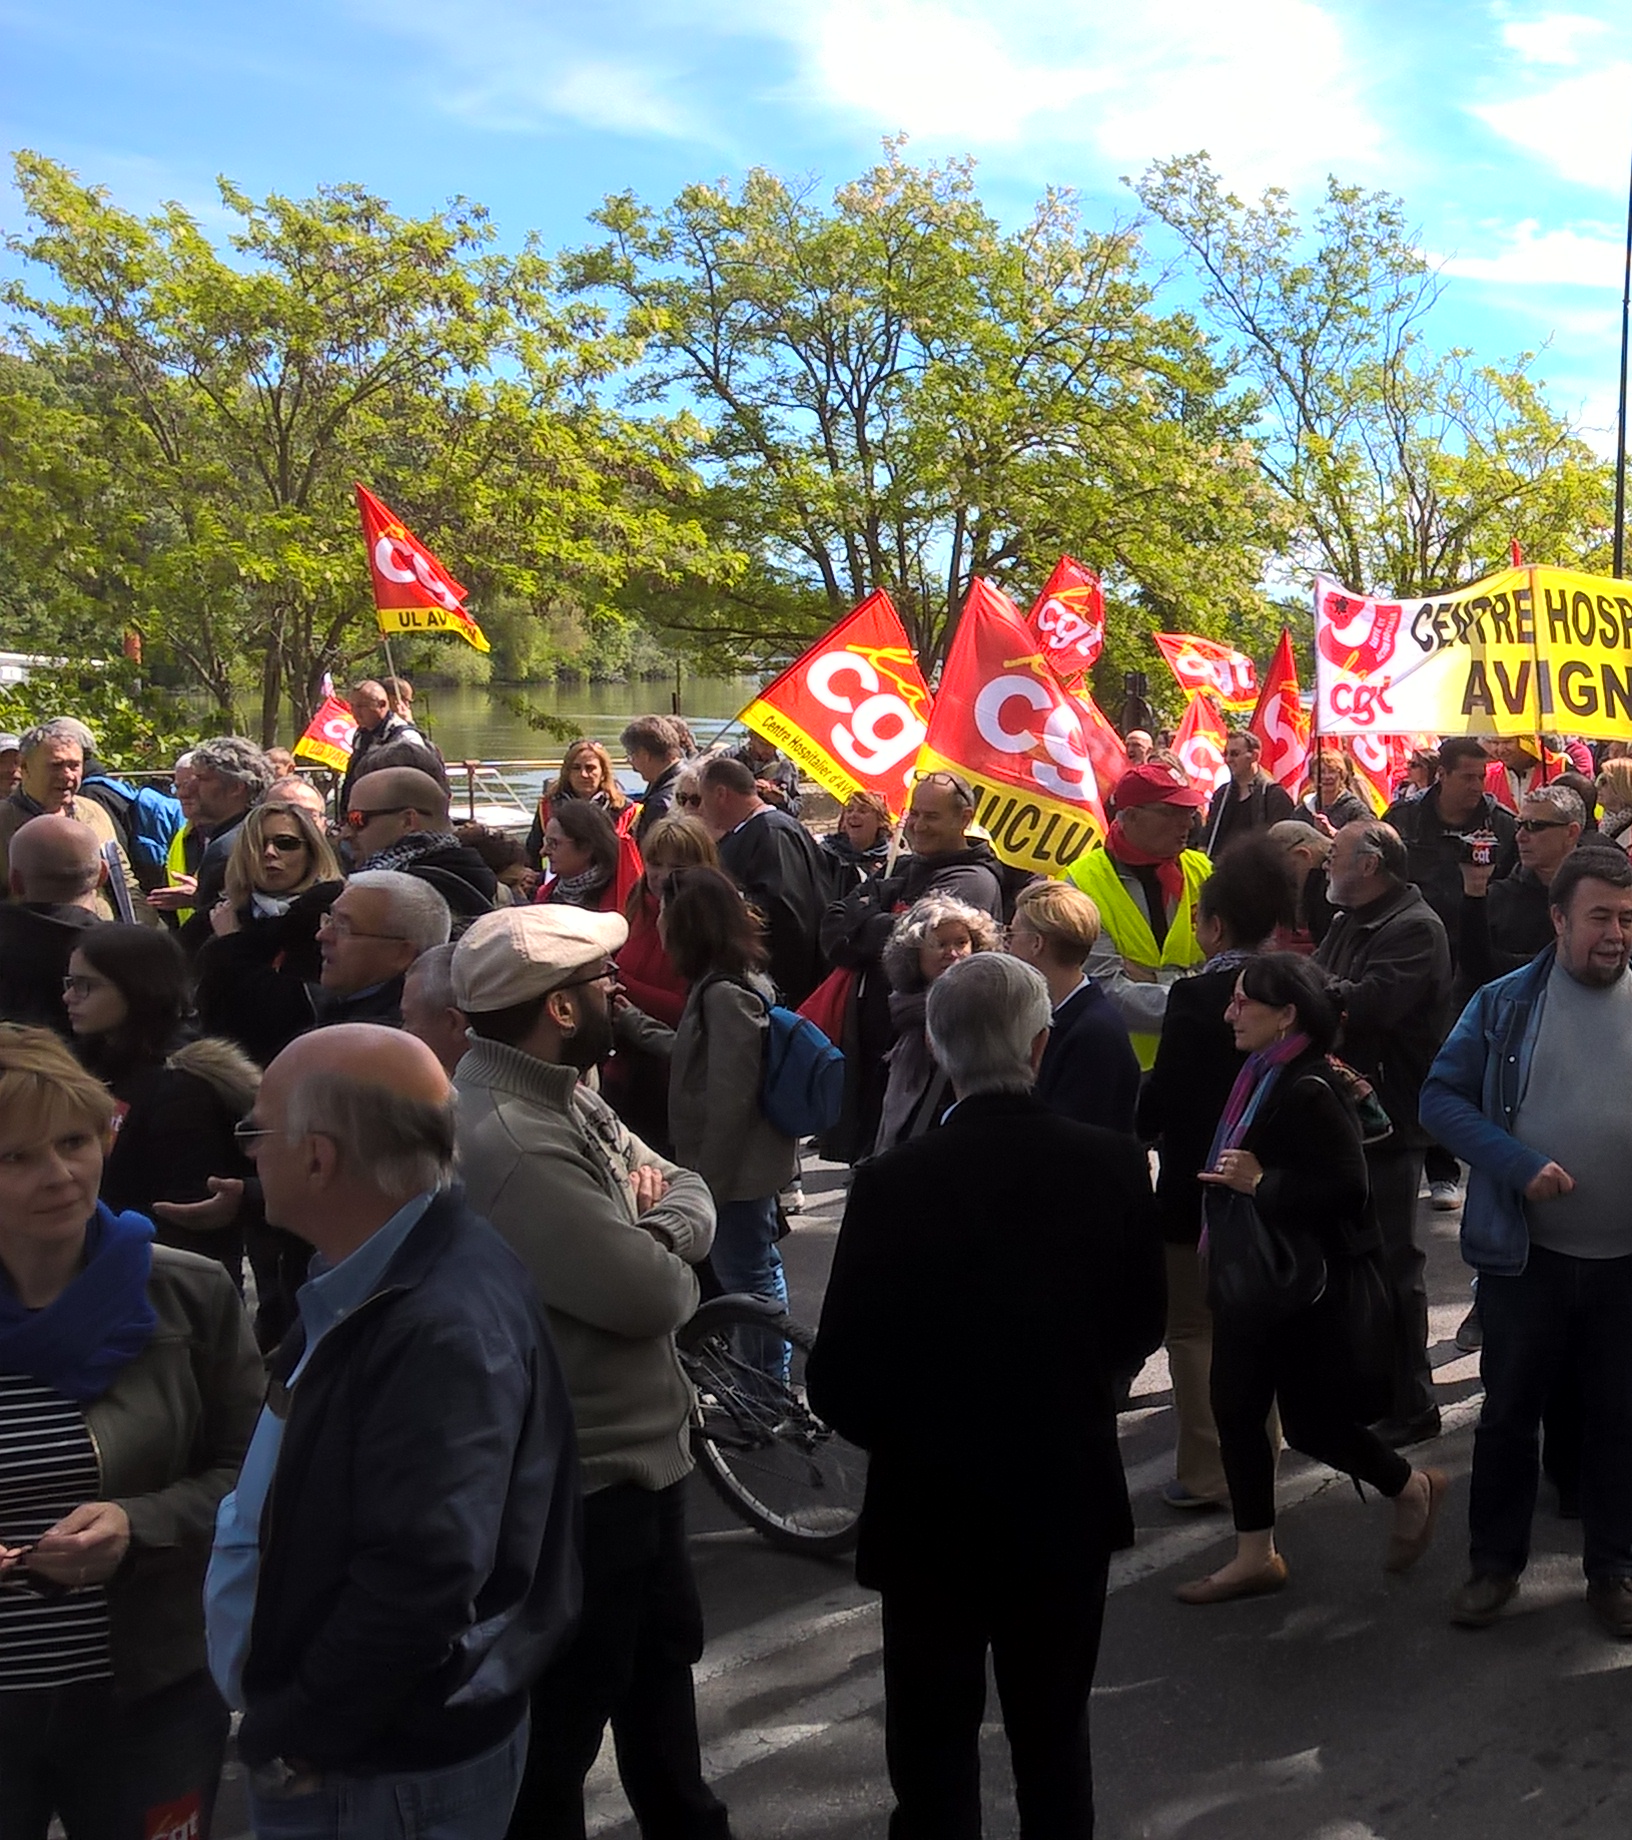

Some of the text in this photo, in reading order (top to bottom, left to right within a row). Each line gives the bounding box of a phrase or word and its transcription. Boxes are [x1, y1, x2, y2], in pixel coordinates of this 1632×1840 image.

[398, 611, 422, 627] UL
[1038, 599, 1102, 656] cgt
[1410, 588, 1536, 653] CENTRE
[1330, 676, 1394, 726] cgt
[761, 715, 792, 743] Centre
[787, 735, 832, 779] Hospitalier
[973, 674, 1099, 802] cg
